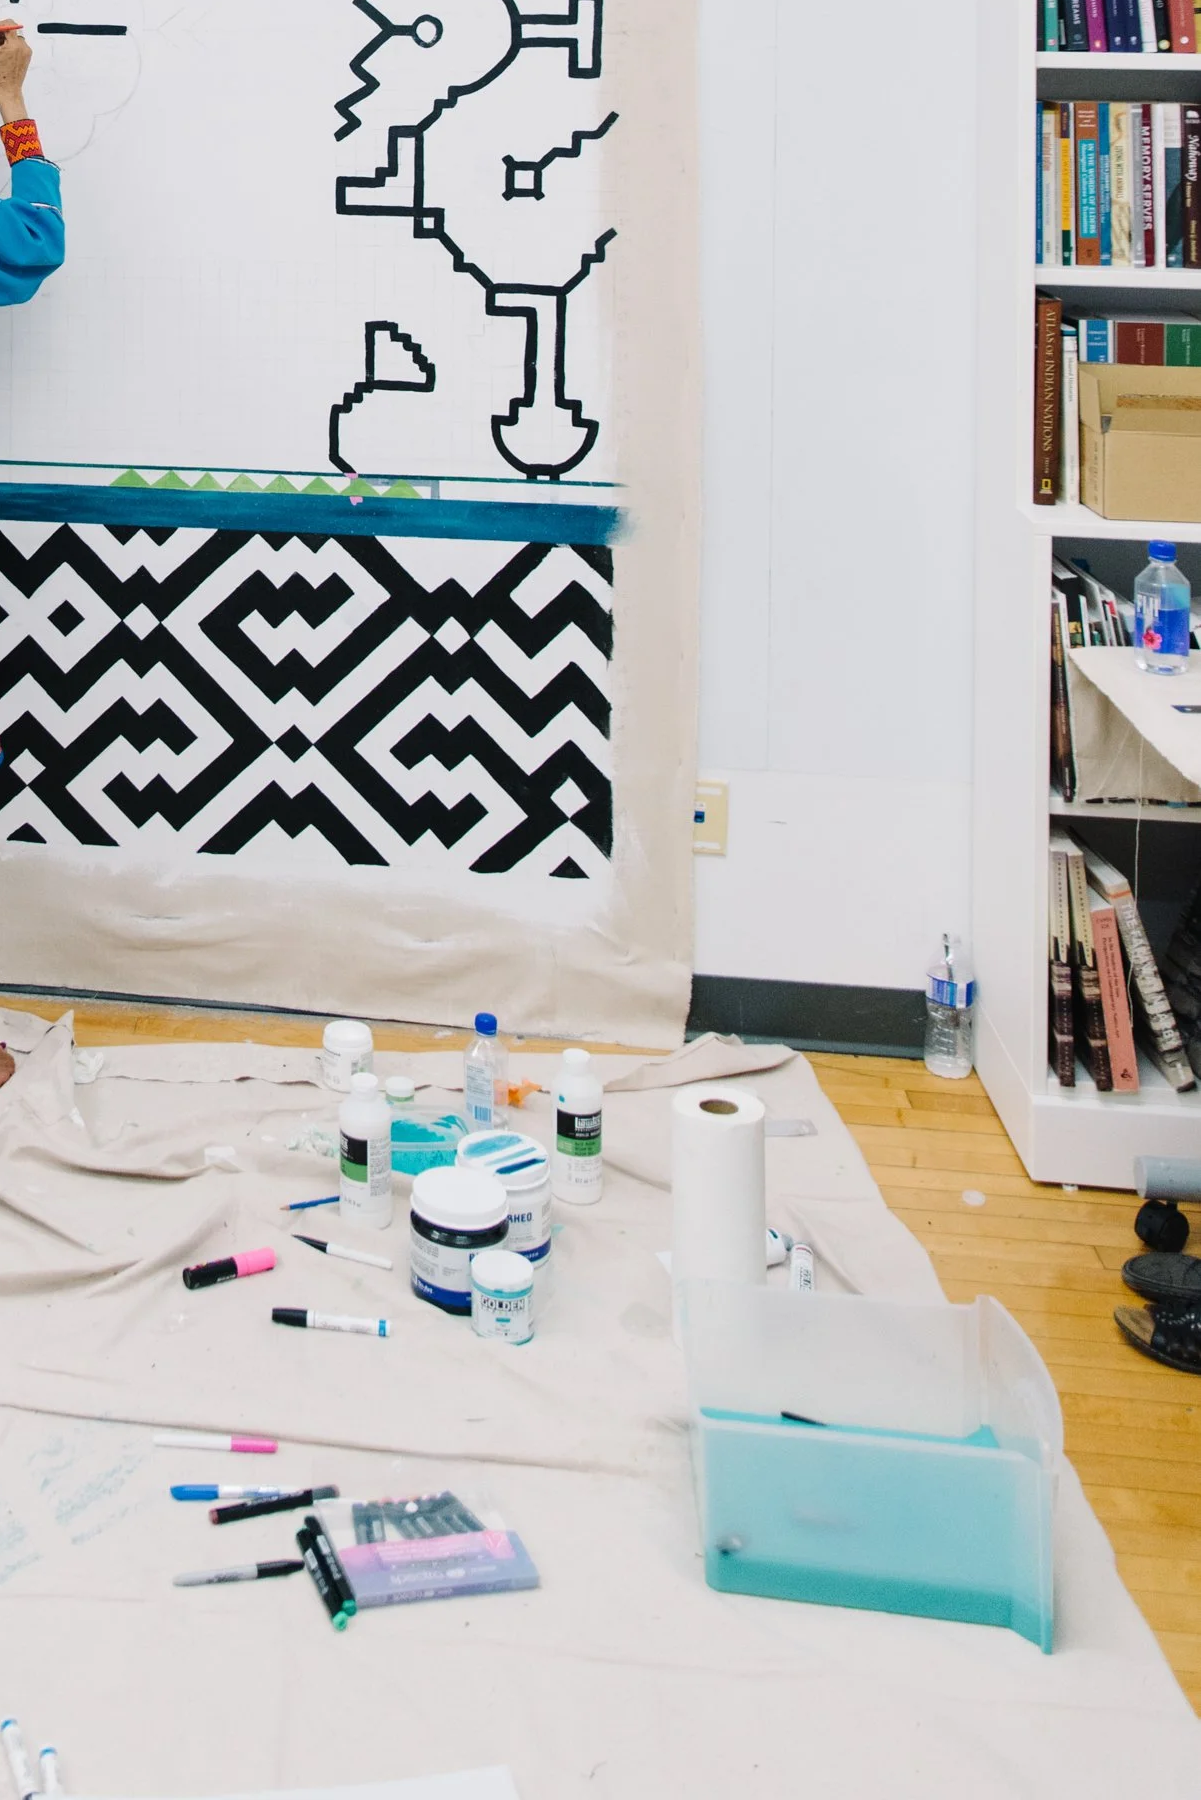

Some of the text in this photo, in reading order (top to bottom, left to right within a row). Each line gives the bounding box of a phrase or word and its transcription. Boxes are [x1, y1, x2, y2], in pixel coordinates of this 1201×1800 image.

[1141, 125, 1153, 230] MEMORY SERVES
[1043, 309, 1056, 451] ATLAS OF INDIAN NATIONS
[480, 1296, 526, 1312] GOLDEN
